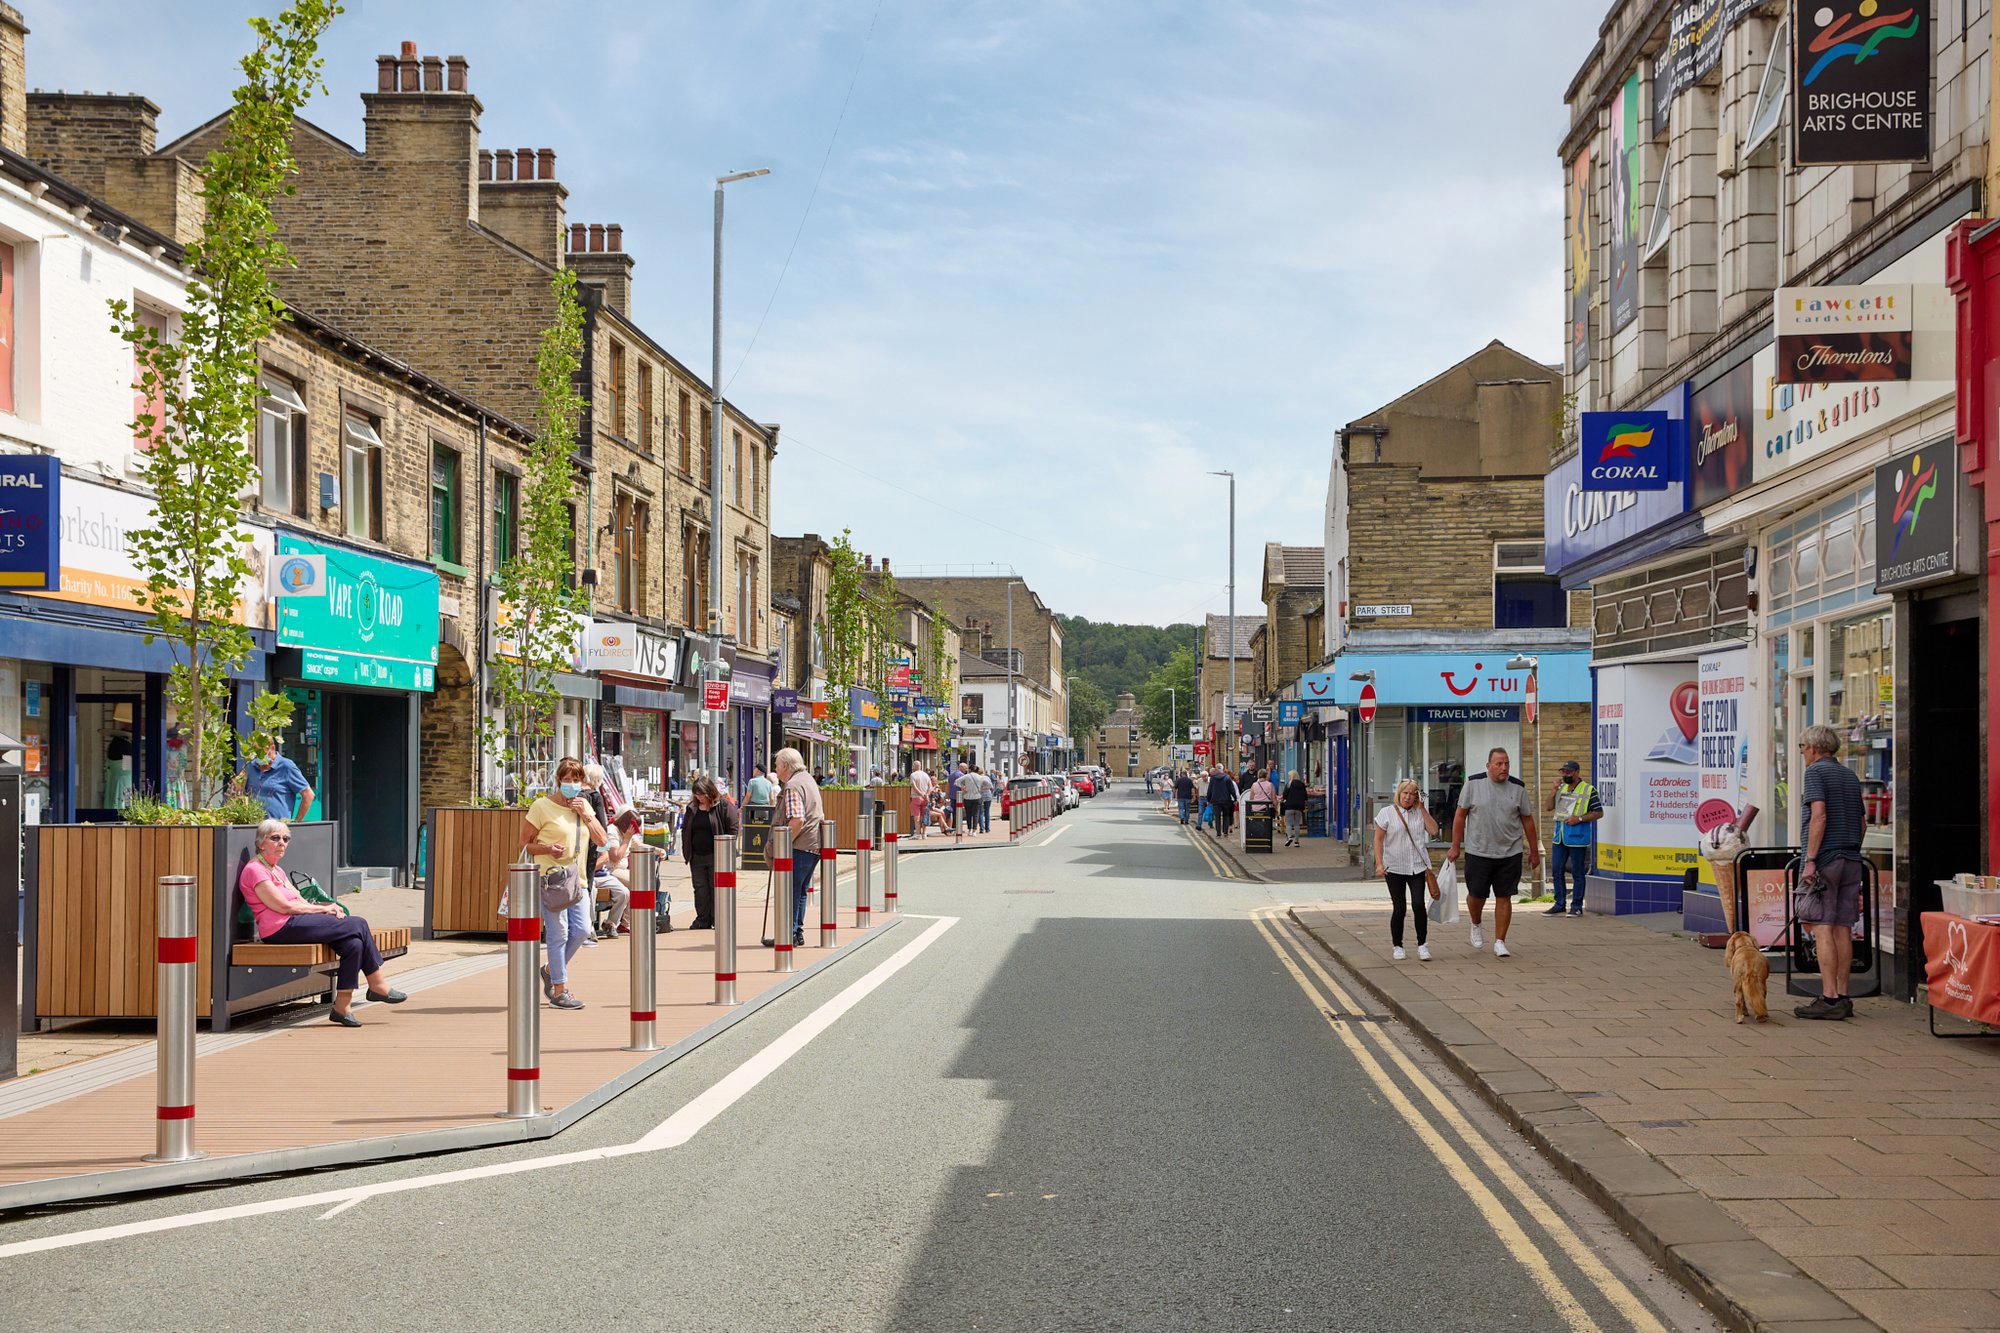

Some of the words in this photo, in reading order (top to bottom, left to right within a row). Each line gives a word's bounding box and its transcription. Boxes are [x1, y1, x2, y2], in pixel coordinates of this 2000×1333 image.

[1809, 91, 1917, 110] BRIGHOUSE
[1803, 115, 1846, 132] ARTS
[1852, 112, 1922, 130] CENTRE
[1795, 295, 1895, 312] Fawcett
[1796, 315, 1839, 323] cards
[1858, 313, 1894, 321] gifts
[1797, 344, 1893, 371] Thorntons
[1766, 419, 1813, 459] cards
[1817, 408, 1827, 433] &
[1831, 385, 1880, 427] gifts
[1697, 416, 1738, 466] Thorntons
[1591, 466, 1659, 479] CORAL
[0, 473, 43, 489] RAL
[0, 534, 26, 547] TS
[1881, 561, 1911, 583] BRIGHOUSE
[1912, 558, 1925, 574] ARTS
[1926, 551, 1949, 571] CENTRE
[60, 573, 92, 597] Charity
[94, 580, 109, 598] No.
[328, 576, 352, 619] VAPE
[379, 587, 403, 627] ROAD
[1357, 606, 1377, 614] PARK
[1381, 606, 1410, 614] STREET
[589, 648, 633, 657] FYLDIRECT
[1488, 678, 1518, 691] TUI
[1428, 709, 1467, 718] TRAVEL
[1470, 709, 1508, 718] MONEY
[1702, 700, 1713, 732] GET
[1715, 699, 1728, 732] £20
[1730, 699, 1738, 731] IN
[1702, 736, 1717, 768] FREE
[1649, 777, 1691, 787] Ladbrokes
[1664, 790, 1688, 798] Bethel
[1656, 800, 1698, 809] Huddersfie
[1649, 811, 1687, 820] Brighouse
[1689, 811, 1696, 819] H
